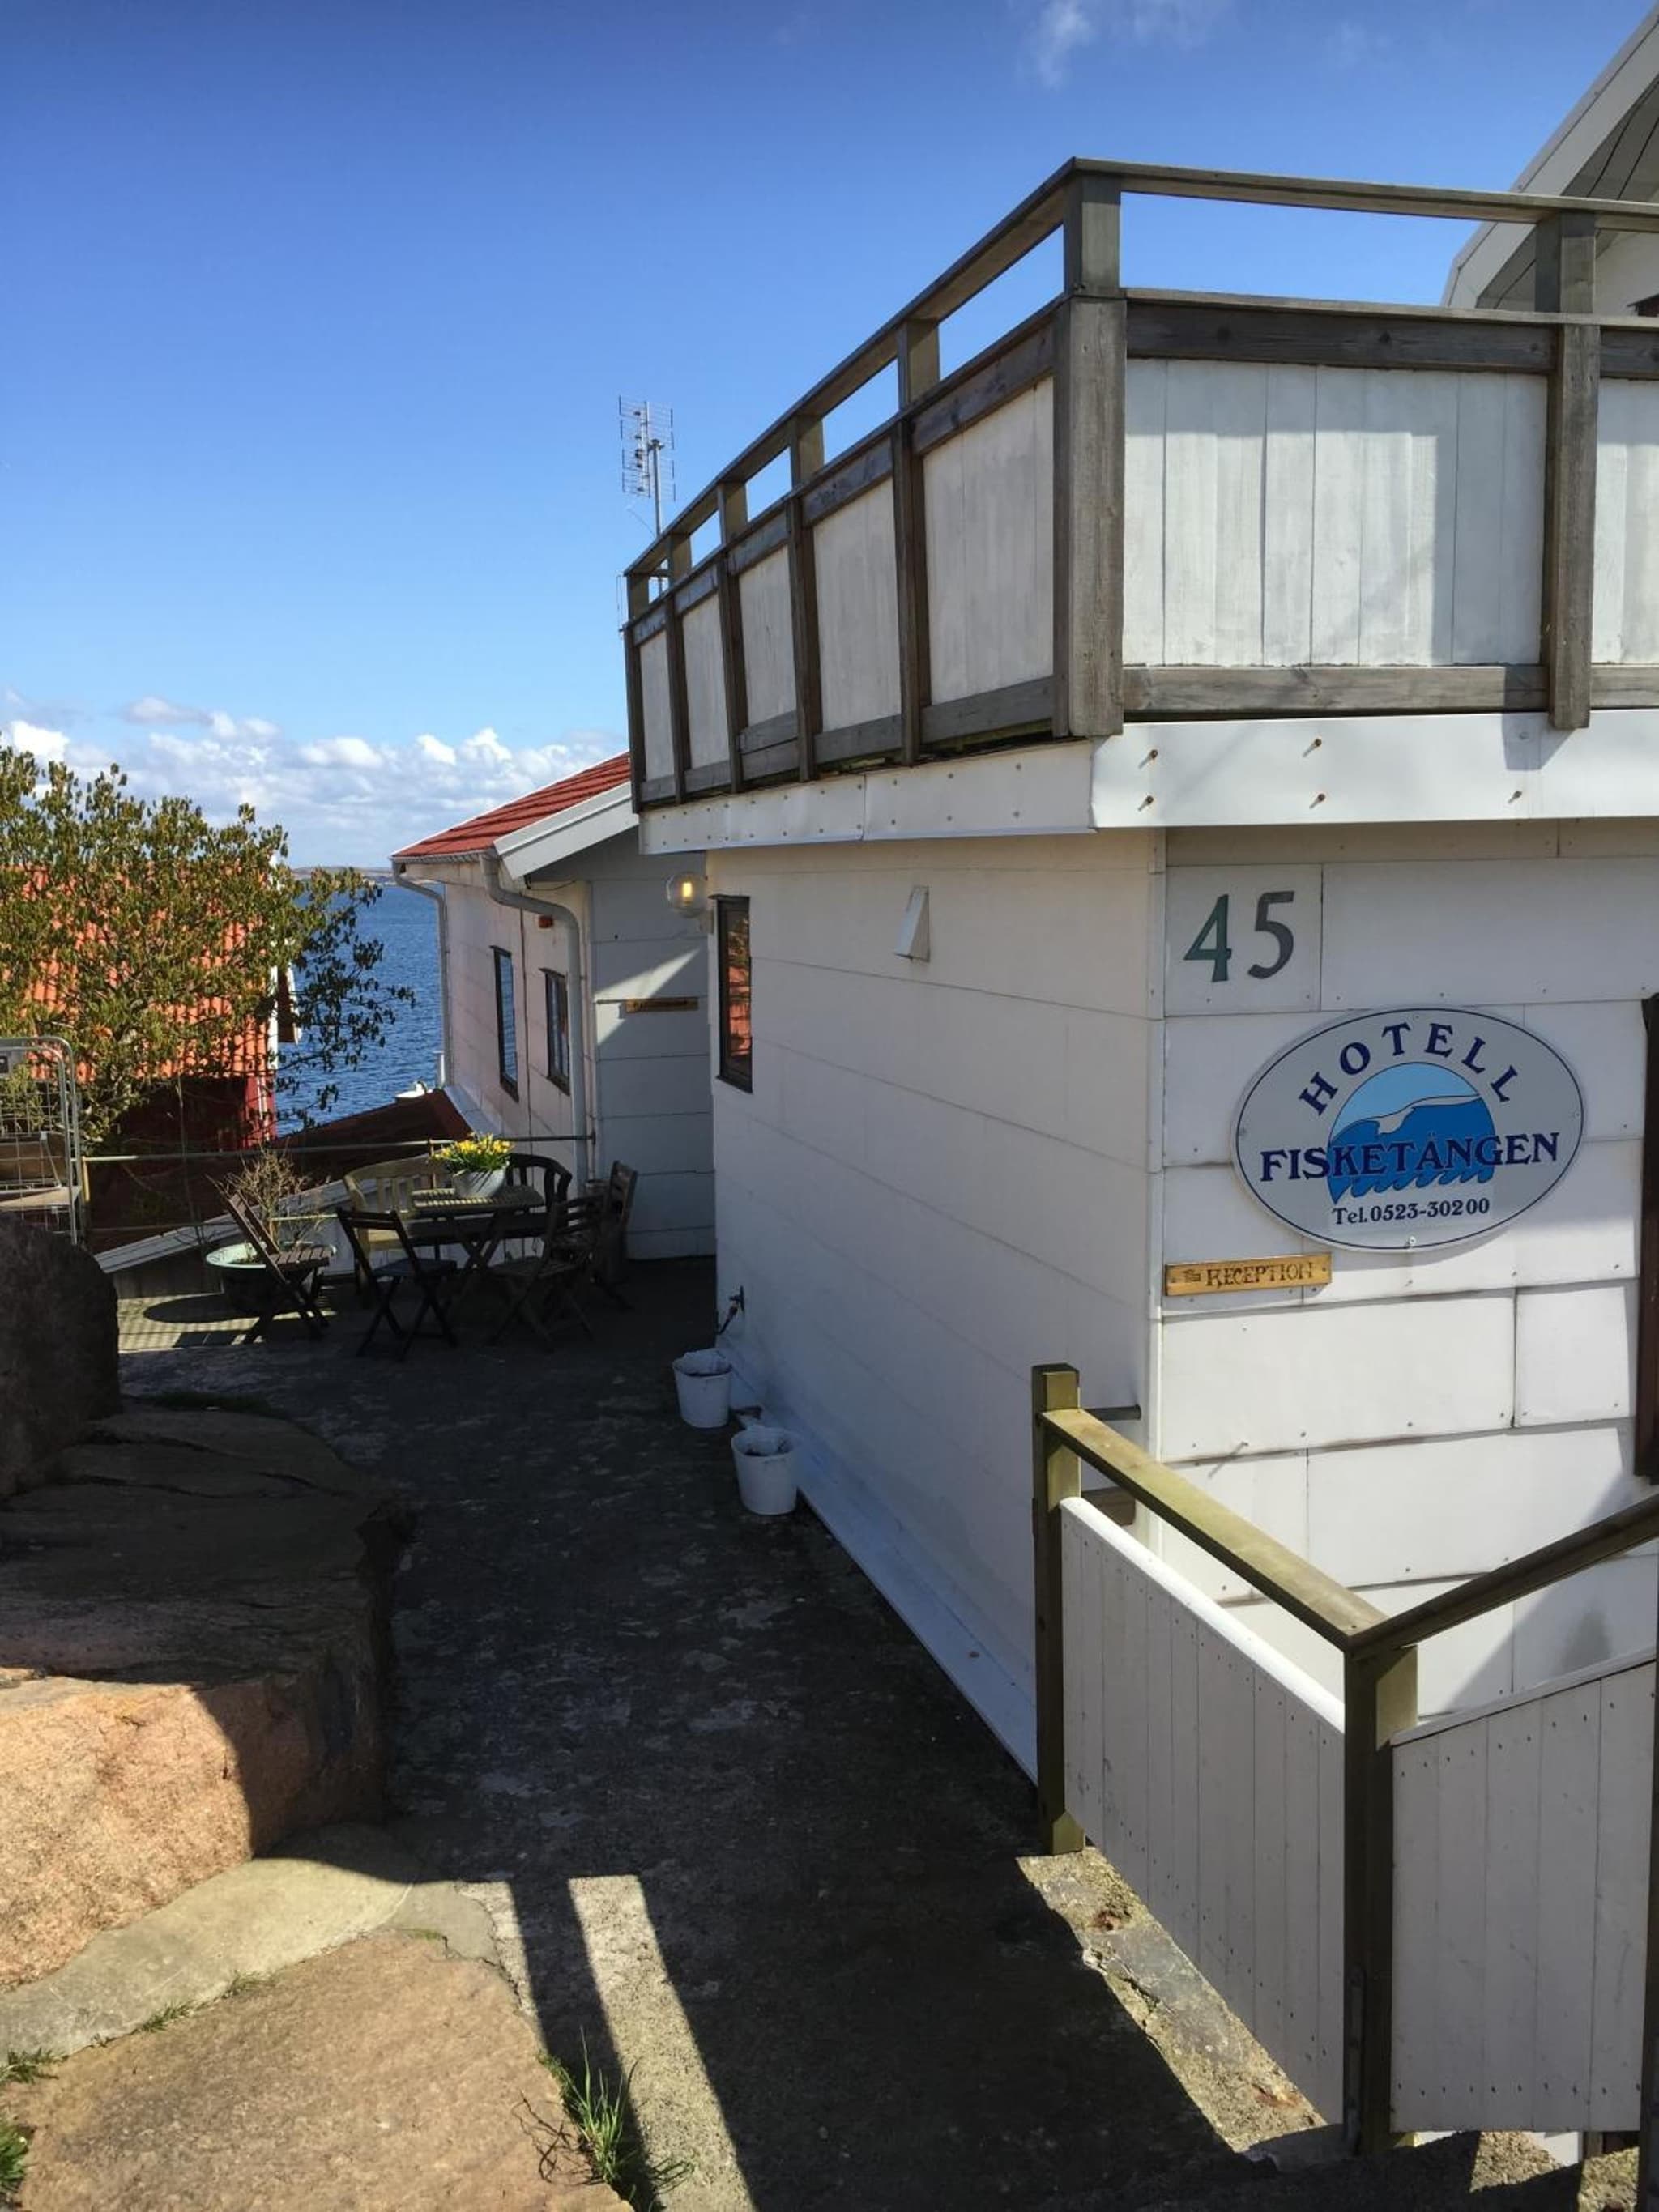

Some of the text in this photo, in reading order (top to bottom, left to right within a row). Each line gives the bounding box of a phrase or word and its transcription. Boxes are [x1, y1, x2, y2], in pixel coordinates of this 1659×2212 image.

[1183, 890, 1294, 982] 45
[1299, 1023, 1519, 1115] HOTELL
[1205, 1261, 1314, 1289] RECEPTION
